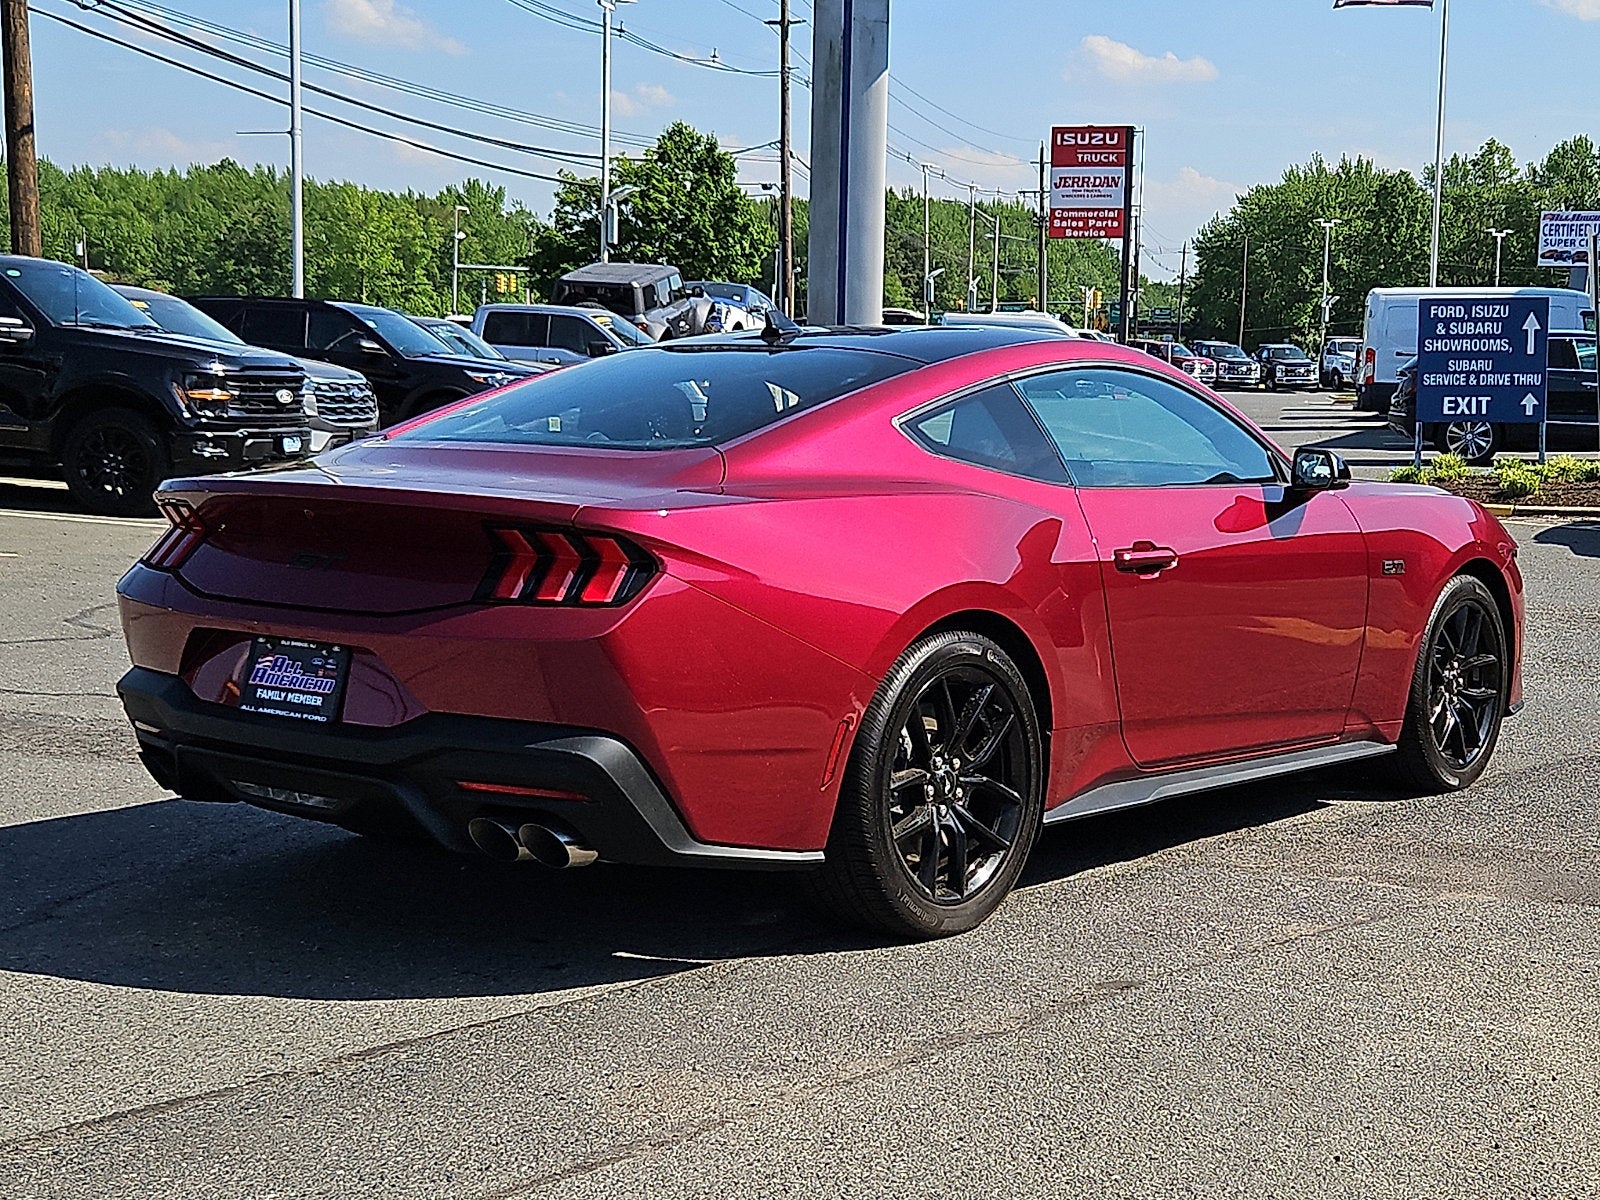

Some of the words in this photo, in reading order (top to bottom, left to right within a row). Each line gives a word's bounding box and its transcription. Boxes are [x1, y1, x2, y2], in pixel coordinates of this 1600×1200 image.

[1057, 133, 1119, 145] ISUZU
[1077, 153, 1118, 162] TRUCK
[1054, 209, 1119, 218] Commercial
[1053, 219, 1084, 227] Sales
[1088, 219, 1119, 227] Parts
[1065, 229, 1106, 237] Service
[1543, 238, 1576, 248] SUPER
[1430, 305, 1468, 320] FORD,
[1471, 305, 1510, 318] ISUZU
[1436, 322, 1446, 335] &
[1449, 322, 1502, 335] SUBARU
[1424, 338, 1513, 353] SHOWROOMS,
[1448, 359, 1493, 371] SUBARU
[1423, 373, 1467, 386] SERVICE
[1468, 373, 1478, 386] &
[1479, 373, 1511, 386] DRIVE
[1512, 373, 1542, 386] THRU
[1443, 396, 1491, 415] EXIT
[256, 688, 287, 701] FAMILY
[287, 692, 323, 706] MEMBER
[240, 704, 257, 712] ALL
[257, 707, 301, 718] AMERICAN
[302, 713, 327, 722] FORD
